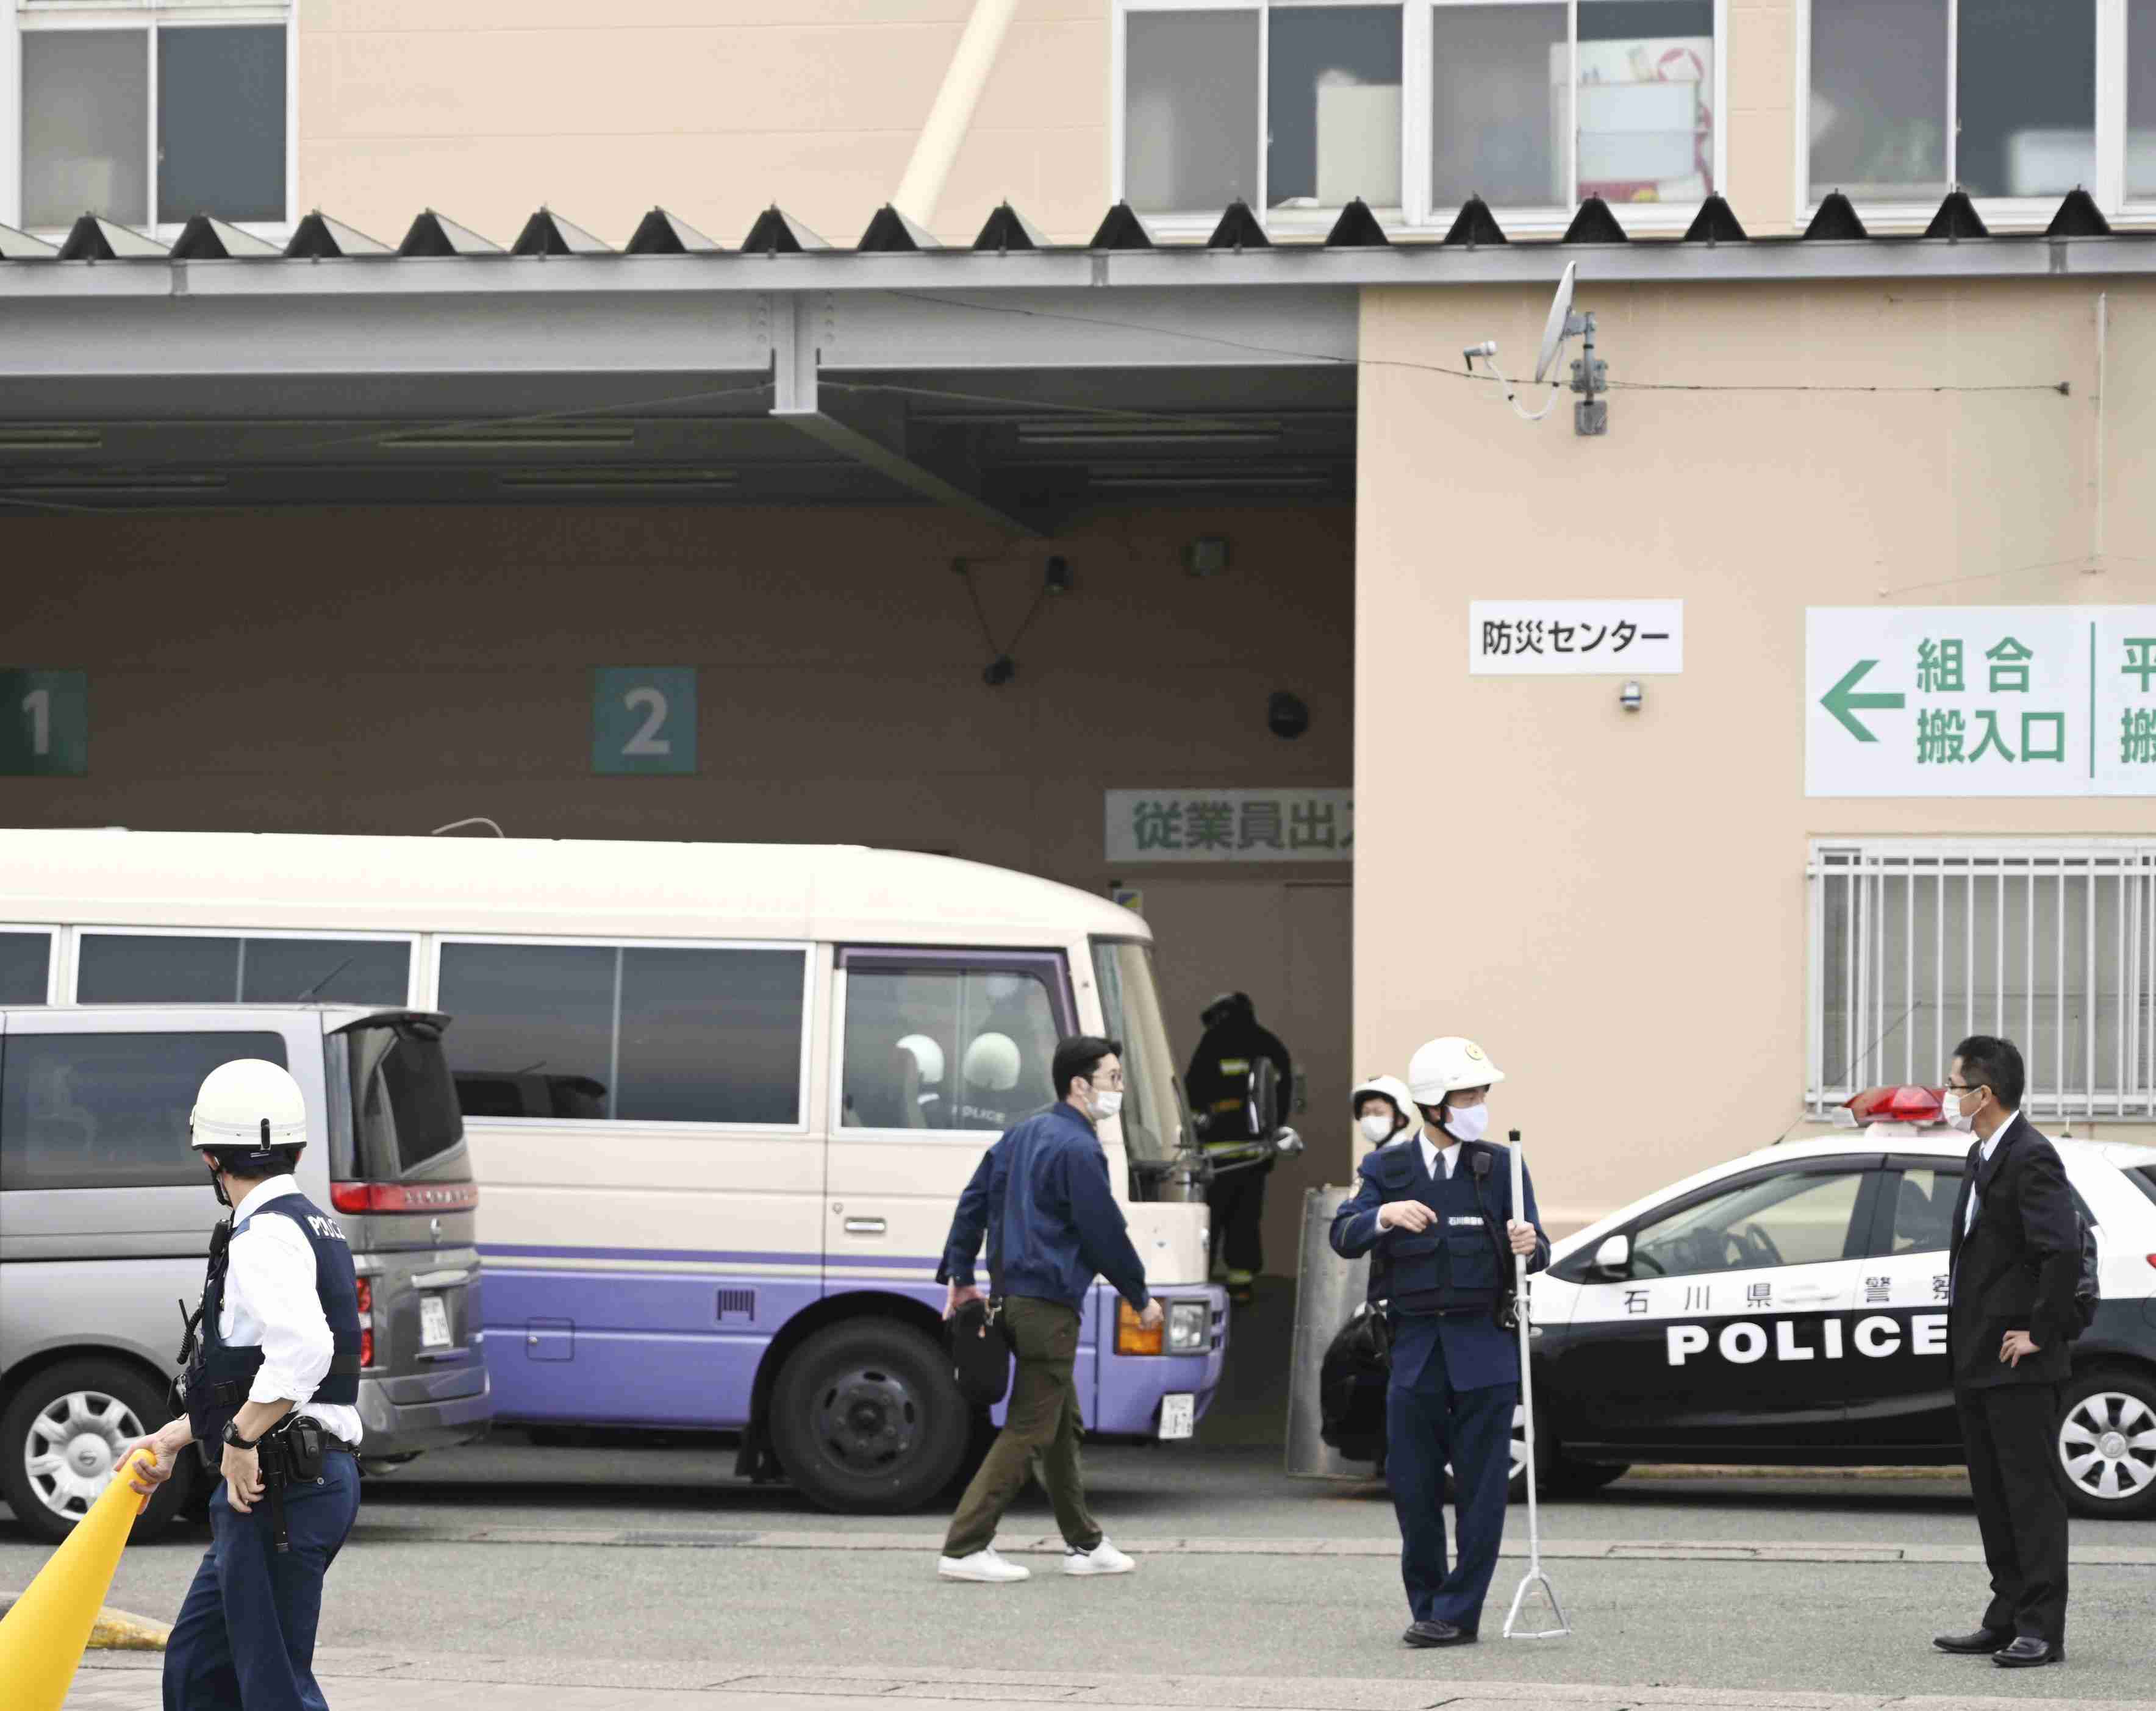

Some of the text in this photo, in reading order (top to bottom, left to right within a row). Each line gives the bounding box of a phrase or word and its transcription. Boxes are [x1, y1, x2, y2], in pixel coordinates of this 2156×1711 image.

[1483, 620, 1669, 655] 防災センター
[1916, 637, 2034, 693] 組合
[2121, 638, 2156, 693] 平
[22, 689, 49, 755] 1
[621, 685, 671, 755] 2
[1916, 708, 2065, 763] 搬入口
[1132, 799, 1353, 851] 従業員出
[1666, 1313, 1947, 1366] POLICE
